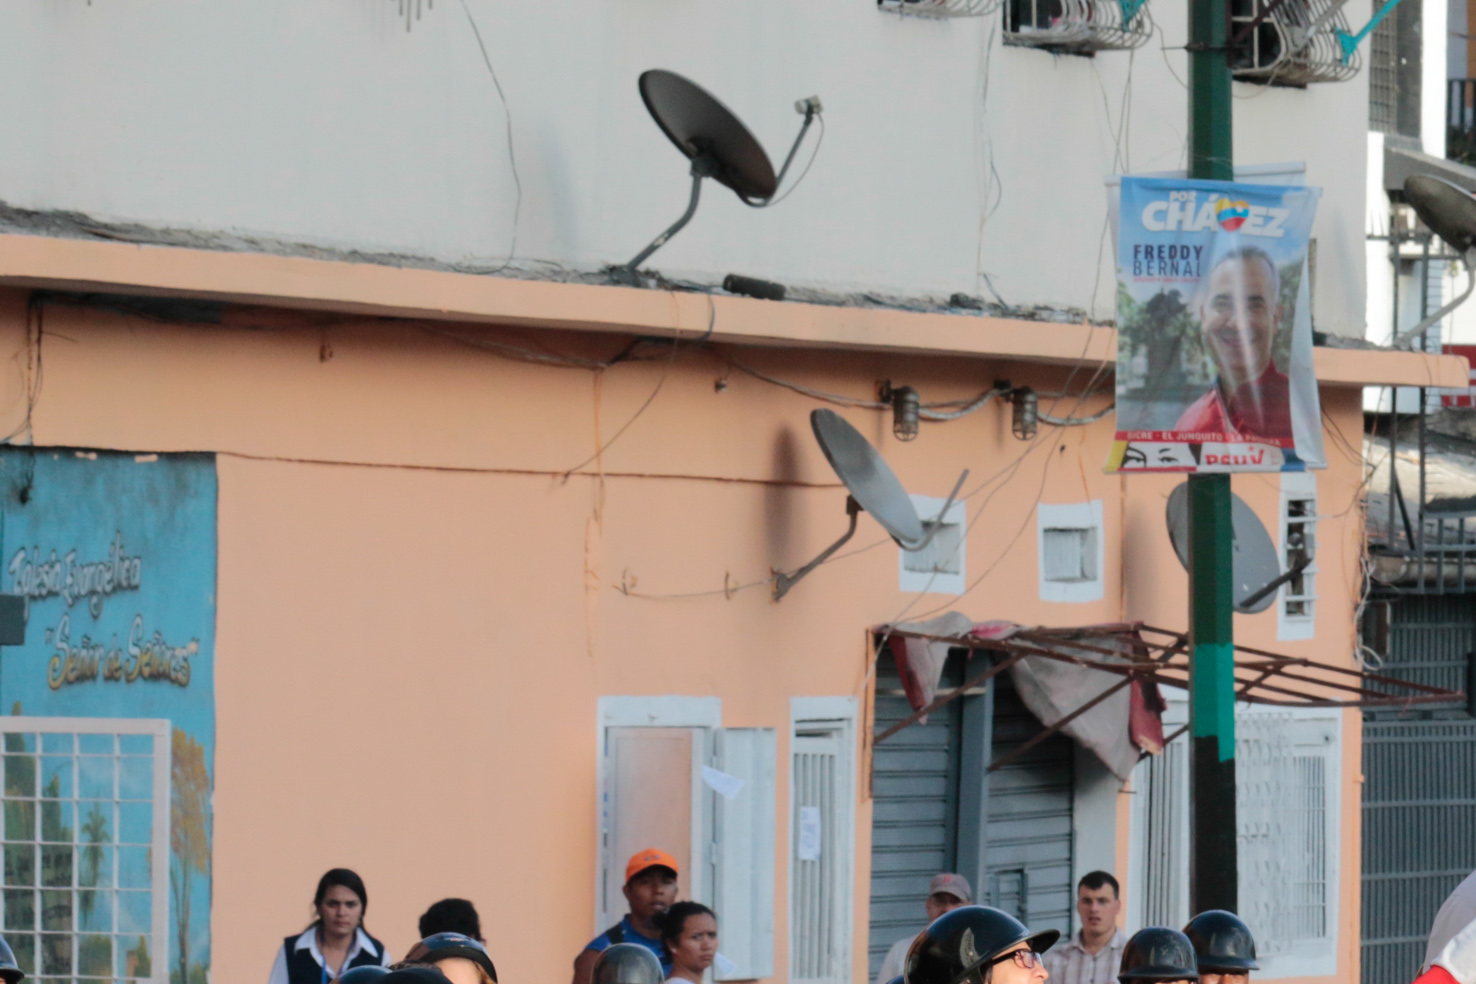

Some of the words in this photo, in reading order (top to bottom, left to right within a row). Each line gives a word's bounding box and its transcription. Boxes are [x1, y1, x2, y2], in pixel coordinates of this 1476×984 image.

[1133, 244, 1205, 261] FREDDY
[1133, 260, 1202, 277] BERNAL
[1161, 431, 1174, 441] EL
